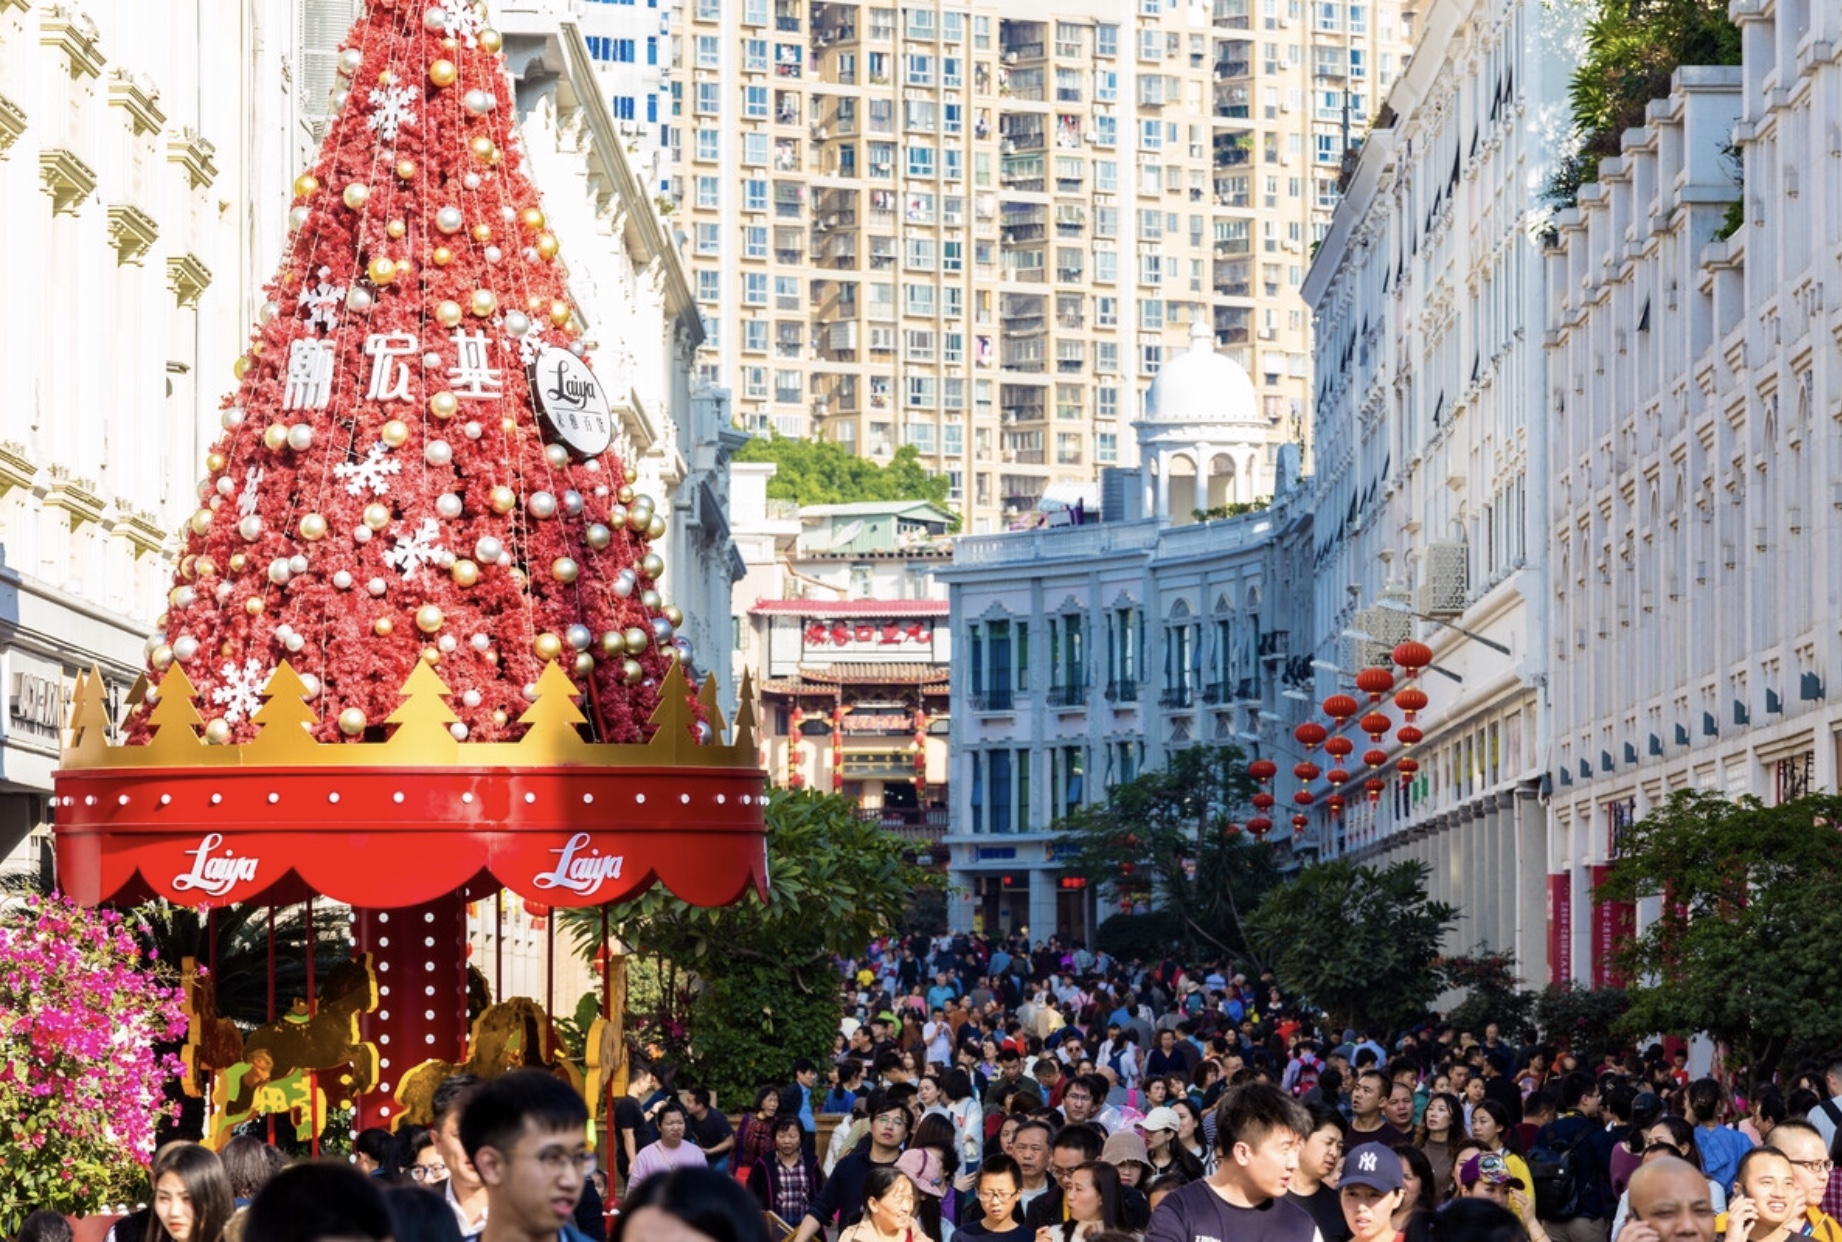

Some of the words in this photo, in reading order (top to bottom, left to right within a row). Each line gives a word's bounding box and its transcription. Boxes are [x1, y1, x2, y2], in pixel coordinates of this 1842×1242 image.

[547, 360, 596, 409] Laiya
[172, 833, 259, 896] Laiya
[532, 832, 623, 895] Laiya
[1358, 1151, 1378, 1171] NY
